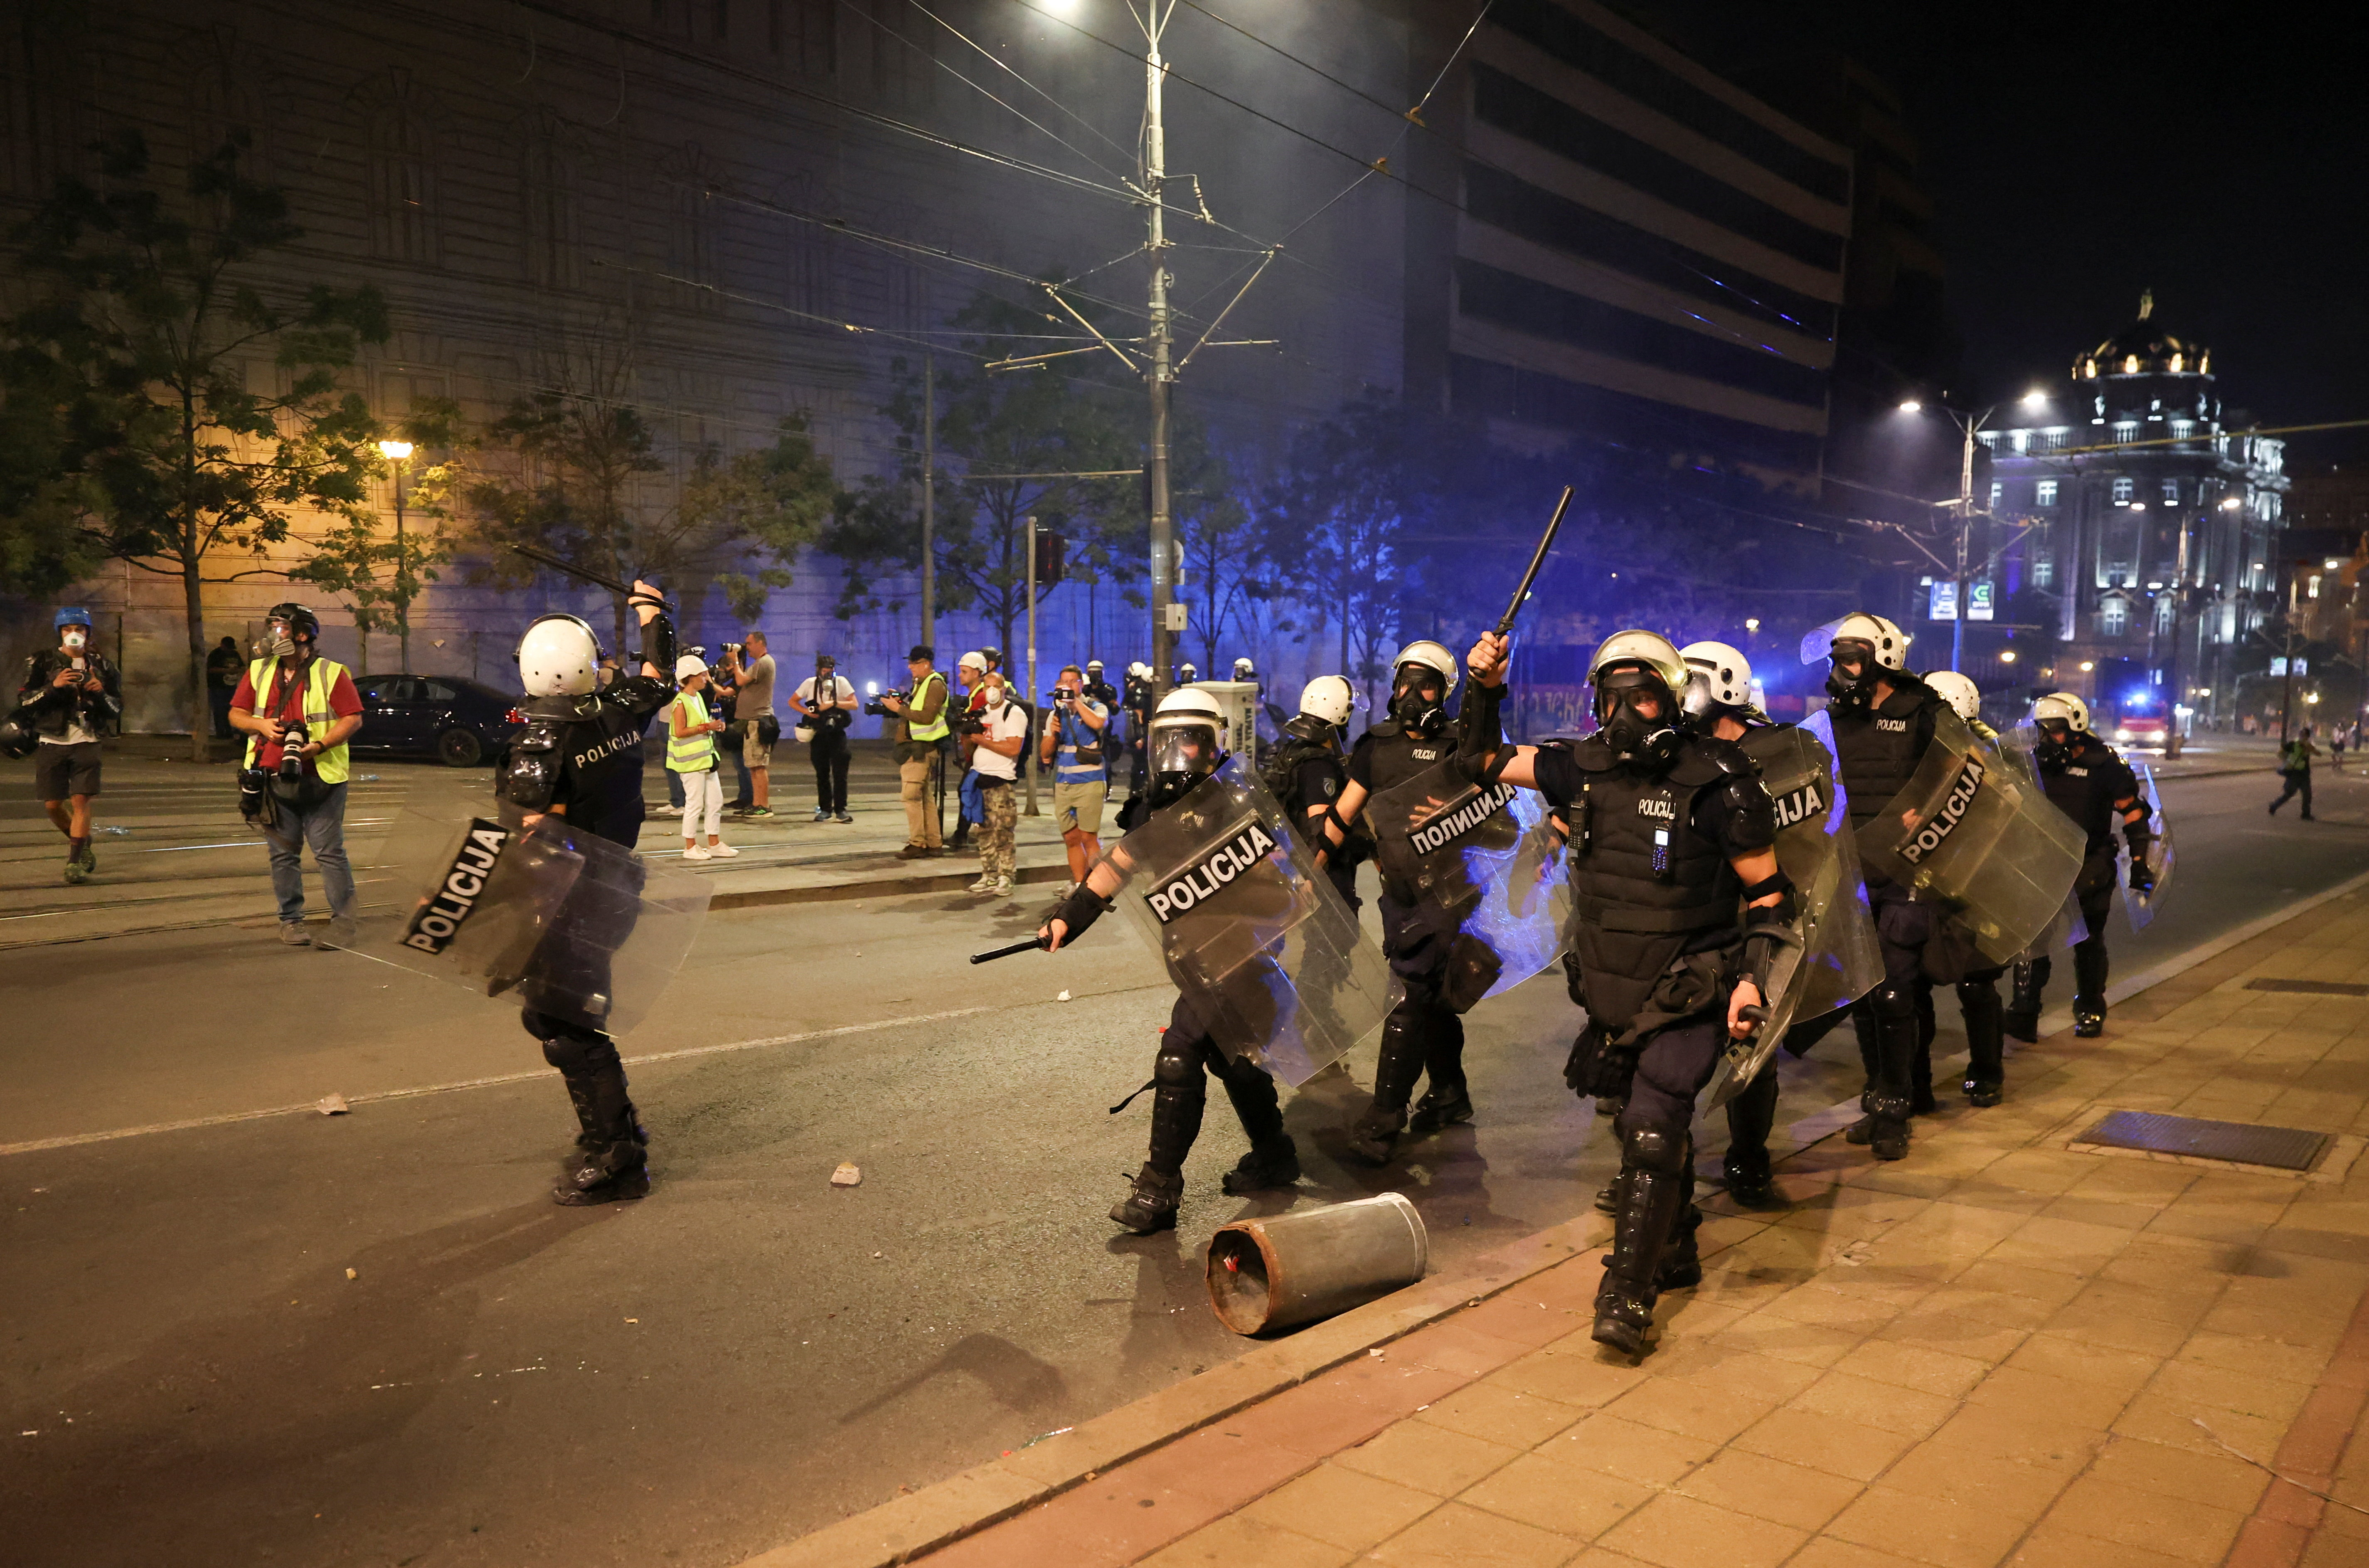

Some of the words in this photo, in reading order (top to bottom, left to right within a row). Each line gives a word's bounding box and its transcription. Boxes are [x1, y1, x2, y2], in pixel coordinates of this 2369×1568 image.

[575, 730, 641, 768] POLICIJA
[1876, 719, 1906, 732] POLICIJA
[1412, 749, 1436, 760] POLICIJA
[1411, 783, 1516, 854] ПОЛИЦИЈА
[1638, 799, 1675, 818] POLICIJ
[1902, 762, 1983, 863] POLICIJA
[407, 830, 507, 952] POLICIJA
[1148, 825, 1273, 922] POLICIJA
